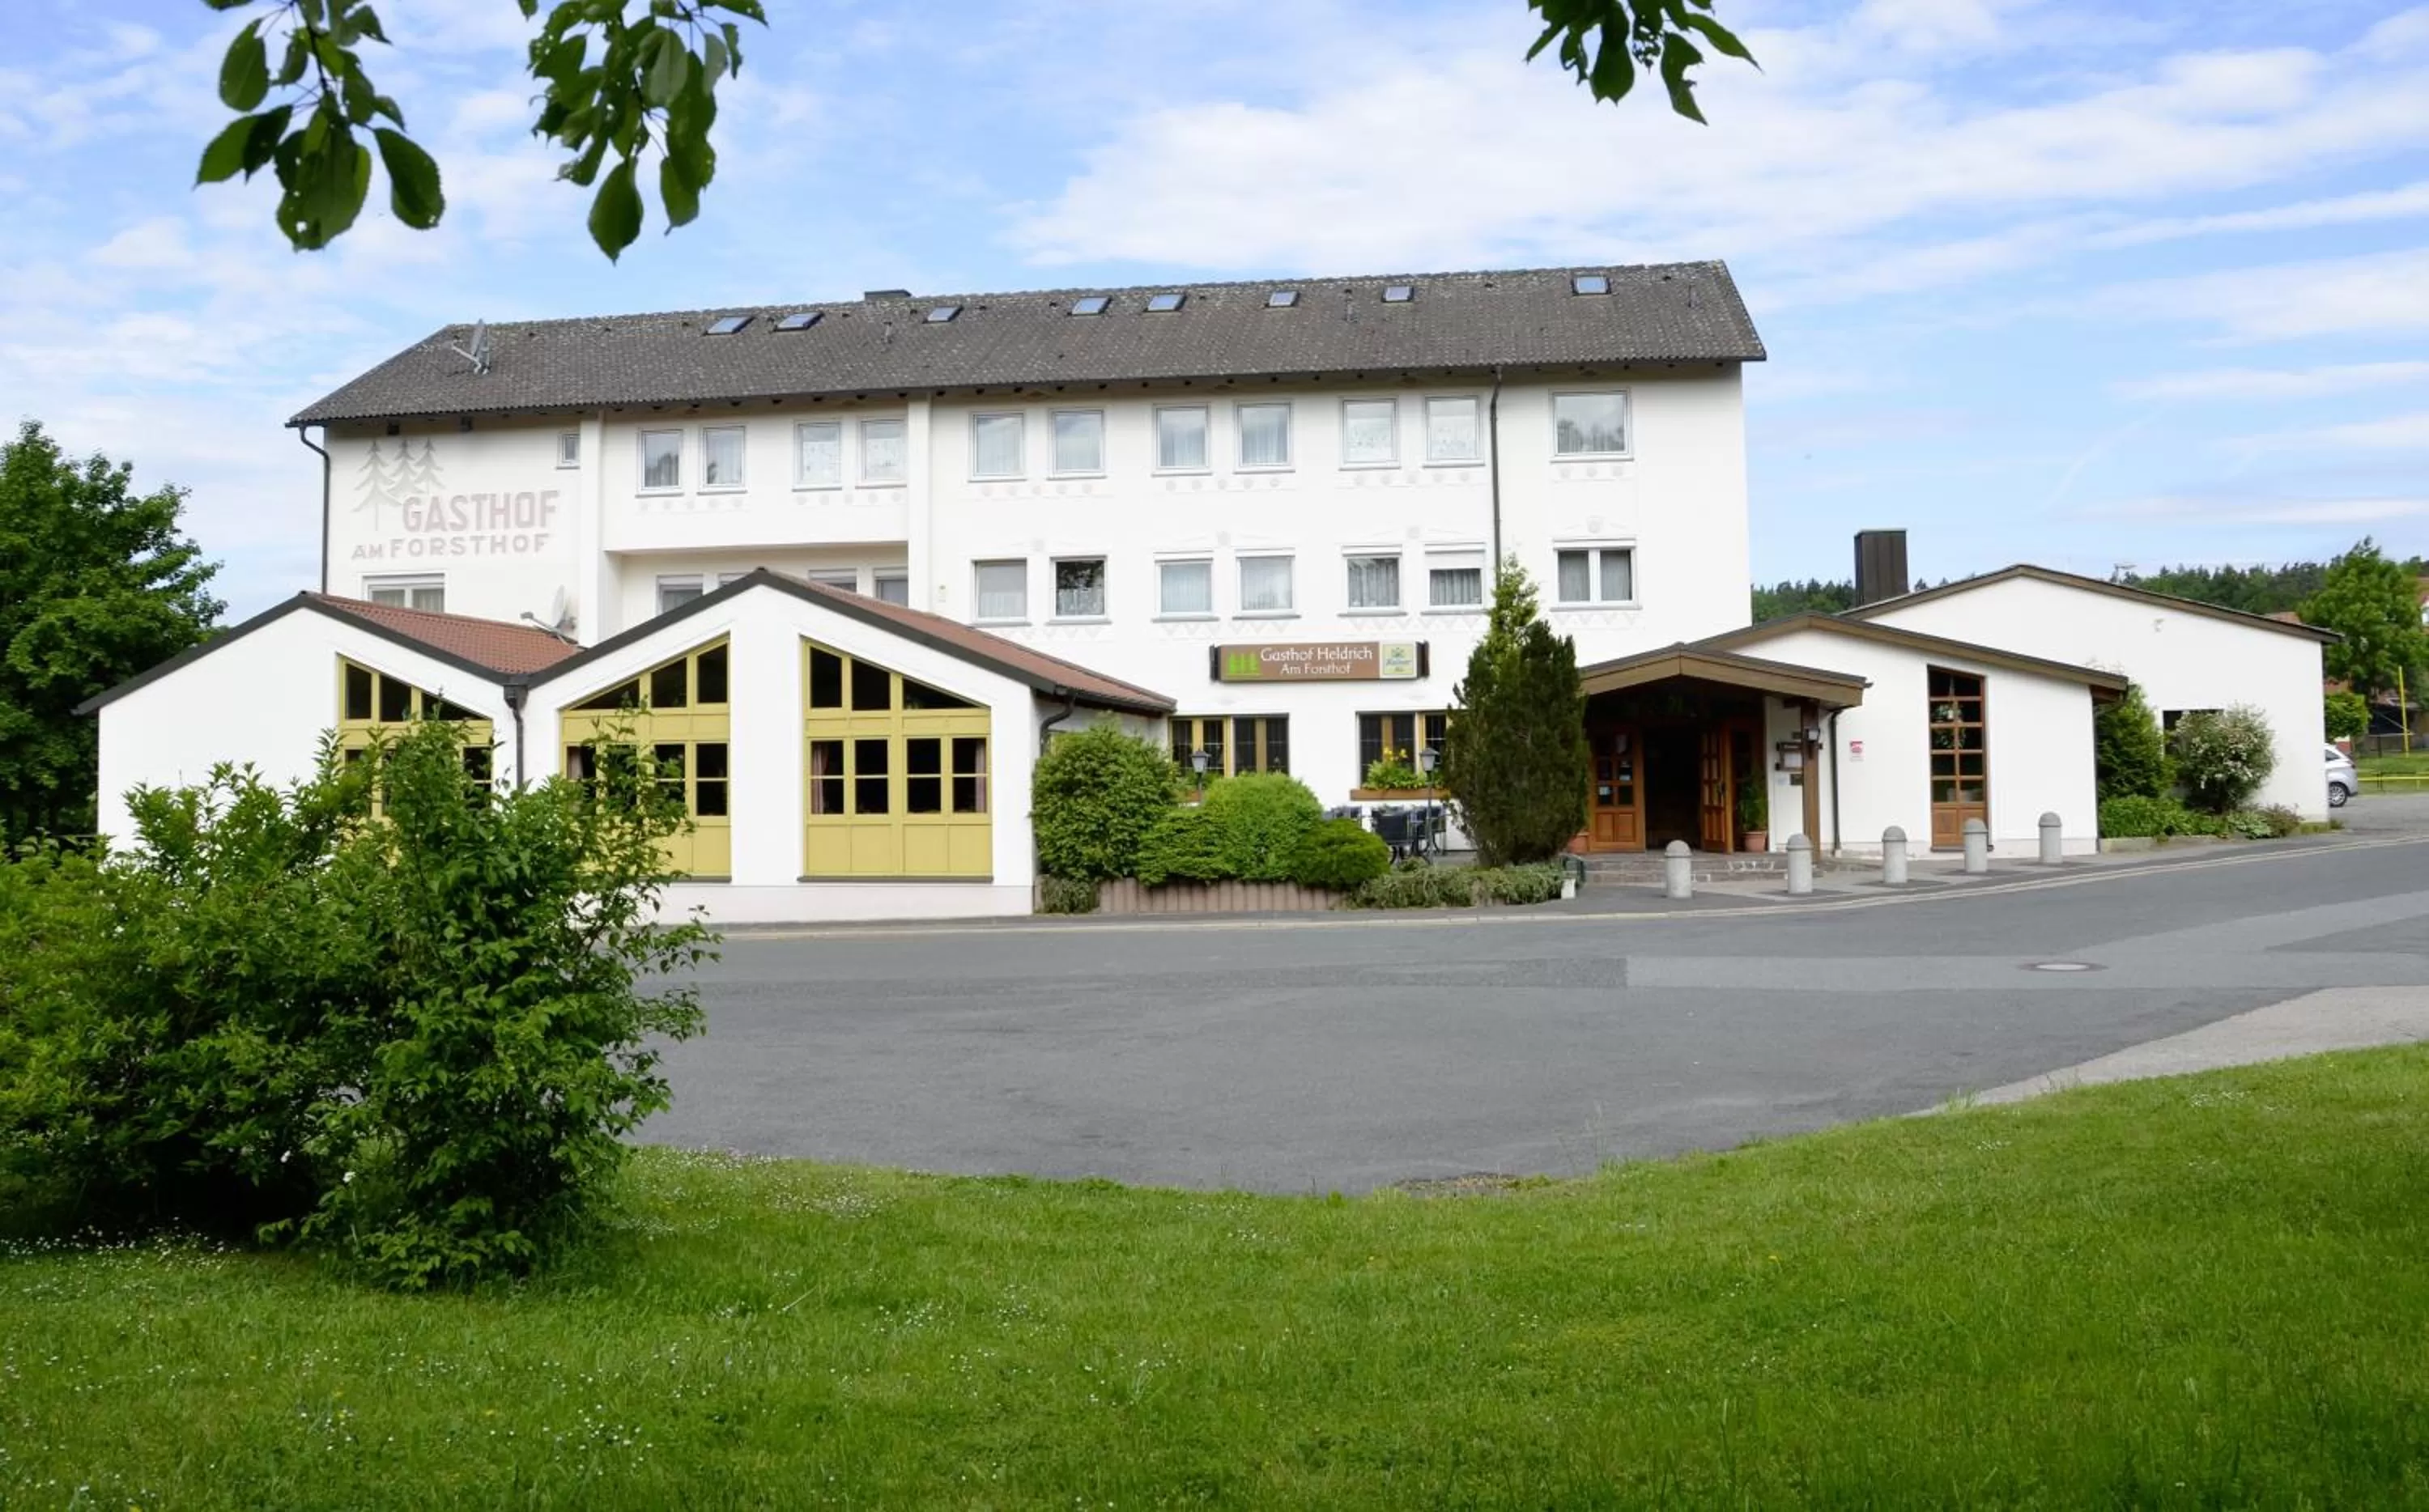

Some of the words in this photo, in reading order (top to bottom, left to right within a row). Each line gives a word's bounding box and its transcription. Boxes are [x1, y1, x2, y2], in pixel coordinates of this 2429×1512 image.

[402, 490, 560, 533] GASTHOF
[351, 545, 384, 560] AM
[389, 533, 551, 559] FORSTHOF
[1260, 647, 1315, 662] Gasthof
[1317, 645, 1373, 661] Heldrich
[1280, 663, 1301, 675] Am
[1304, 661, 1351, 675] Forsthof
